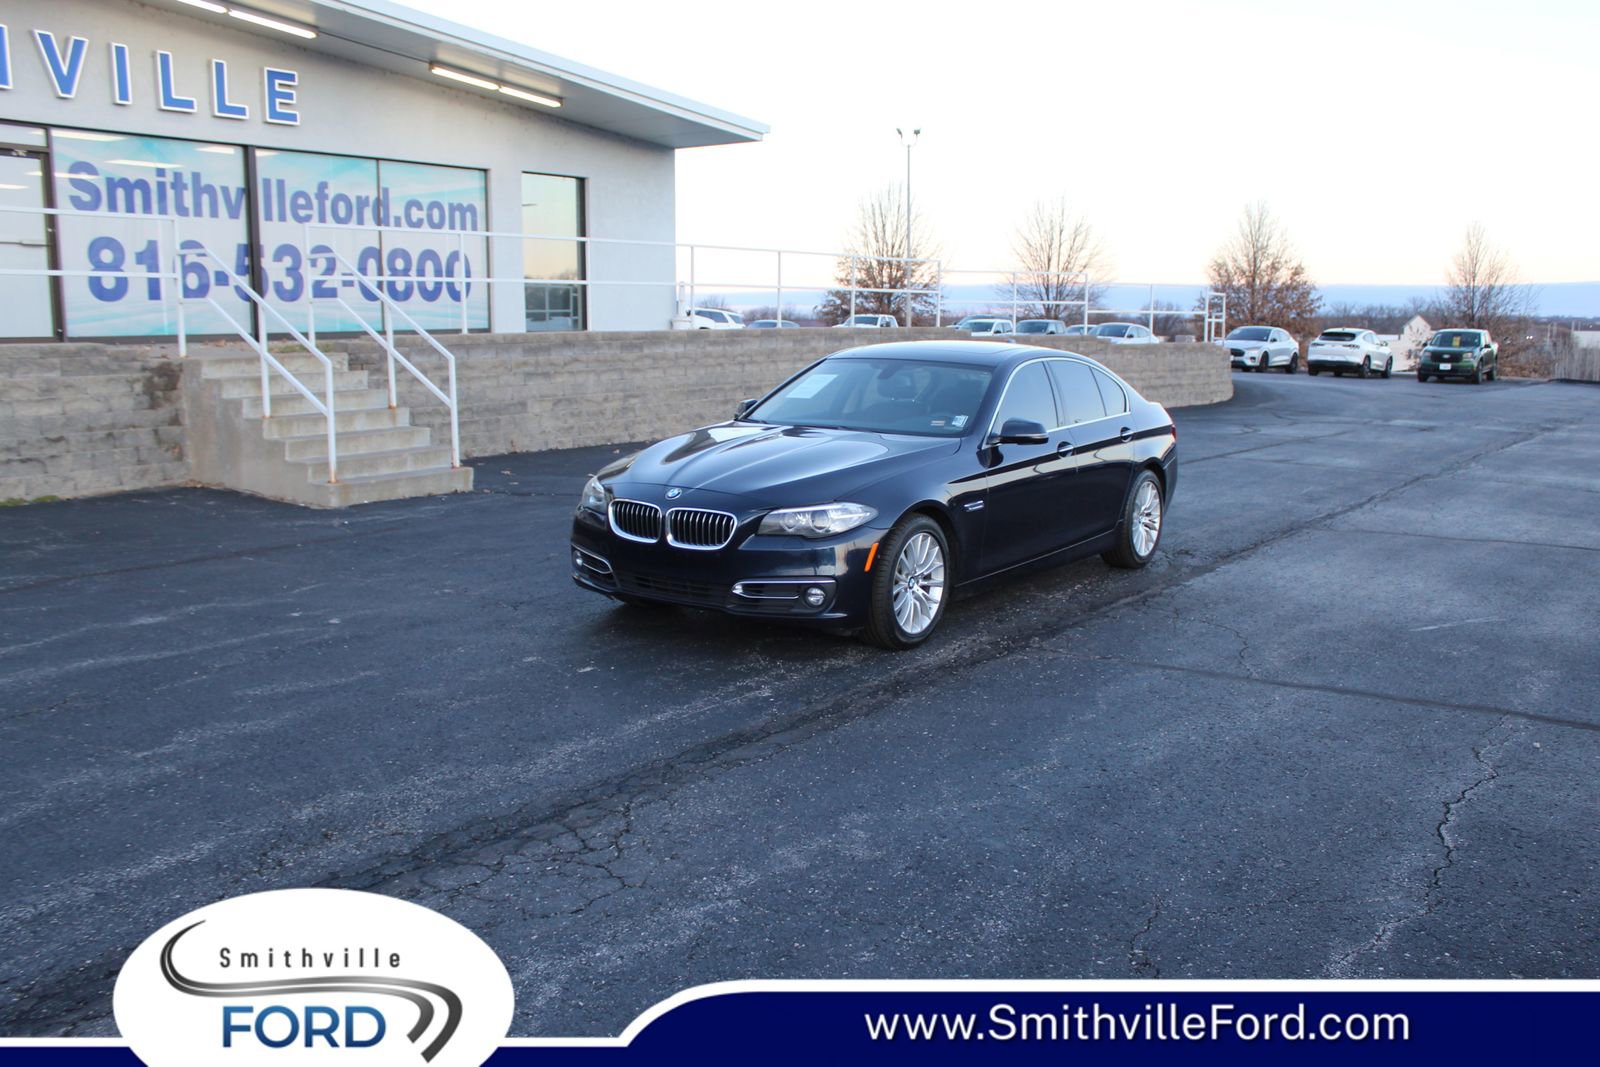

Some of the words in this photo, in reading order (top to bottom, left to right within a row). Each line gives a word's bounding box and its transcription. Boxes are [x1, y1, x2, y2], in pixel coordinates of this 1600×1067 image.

[0, 23, 301, 126] VILLE
[67, 160, 478, 232] Smithvlleford.com
[87, 236, 472, 303] 816-532-0800
